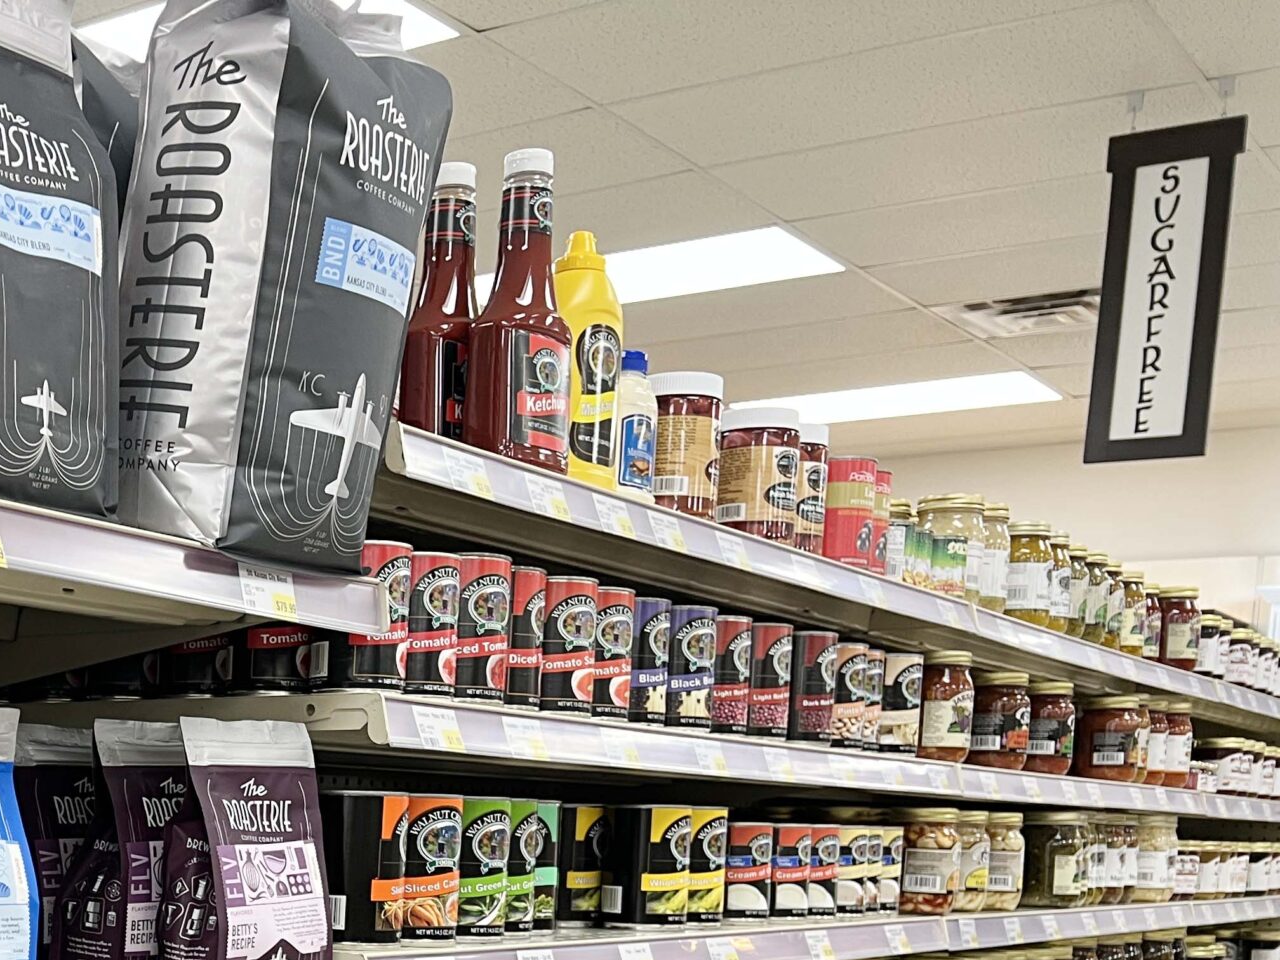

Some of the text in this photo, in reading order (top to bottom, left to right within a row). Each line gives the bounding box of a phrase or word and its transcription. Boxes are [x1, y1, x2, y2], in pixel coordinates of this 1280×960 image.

[173, 40, 247, 91] The
[377, 95, 407, 130] The
[340, 110, 430, 206] ROASTERIE
[23, 175, 67, 191] COMPANY
[356, 179, 415, 217] COFFEE COMPANY
[120, 100, 241, 430] ROASTERIE
[322, 235, 347, 282] BND
[298, 371, 326, 396] KC
[417, 567, 451, 592] WALNUT
[462, 577, 498, 600] WALNUT
[261, 631, 309, 645] Tomato
[407, 637, 450, 649] Tomato
[509, 652, 537, 665] Diced
[671, 676, 701, 689] Black
[241, 777, 268, 797] The
[223, 799, 294, 833] ROASTERIE
[410, 810, 450, 835] WALNUT
[466, 814, 503, 838] WALNUT
[225, 855, 244, 899] FLV
[405, 882, 440, 895] Sliced
[231, 937, 256, 951] RECIPE
